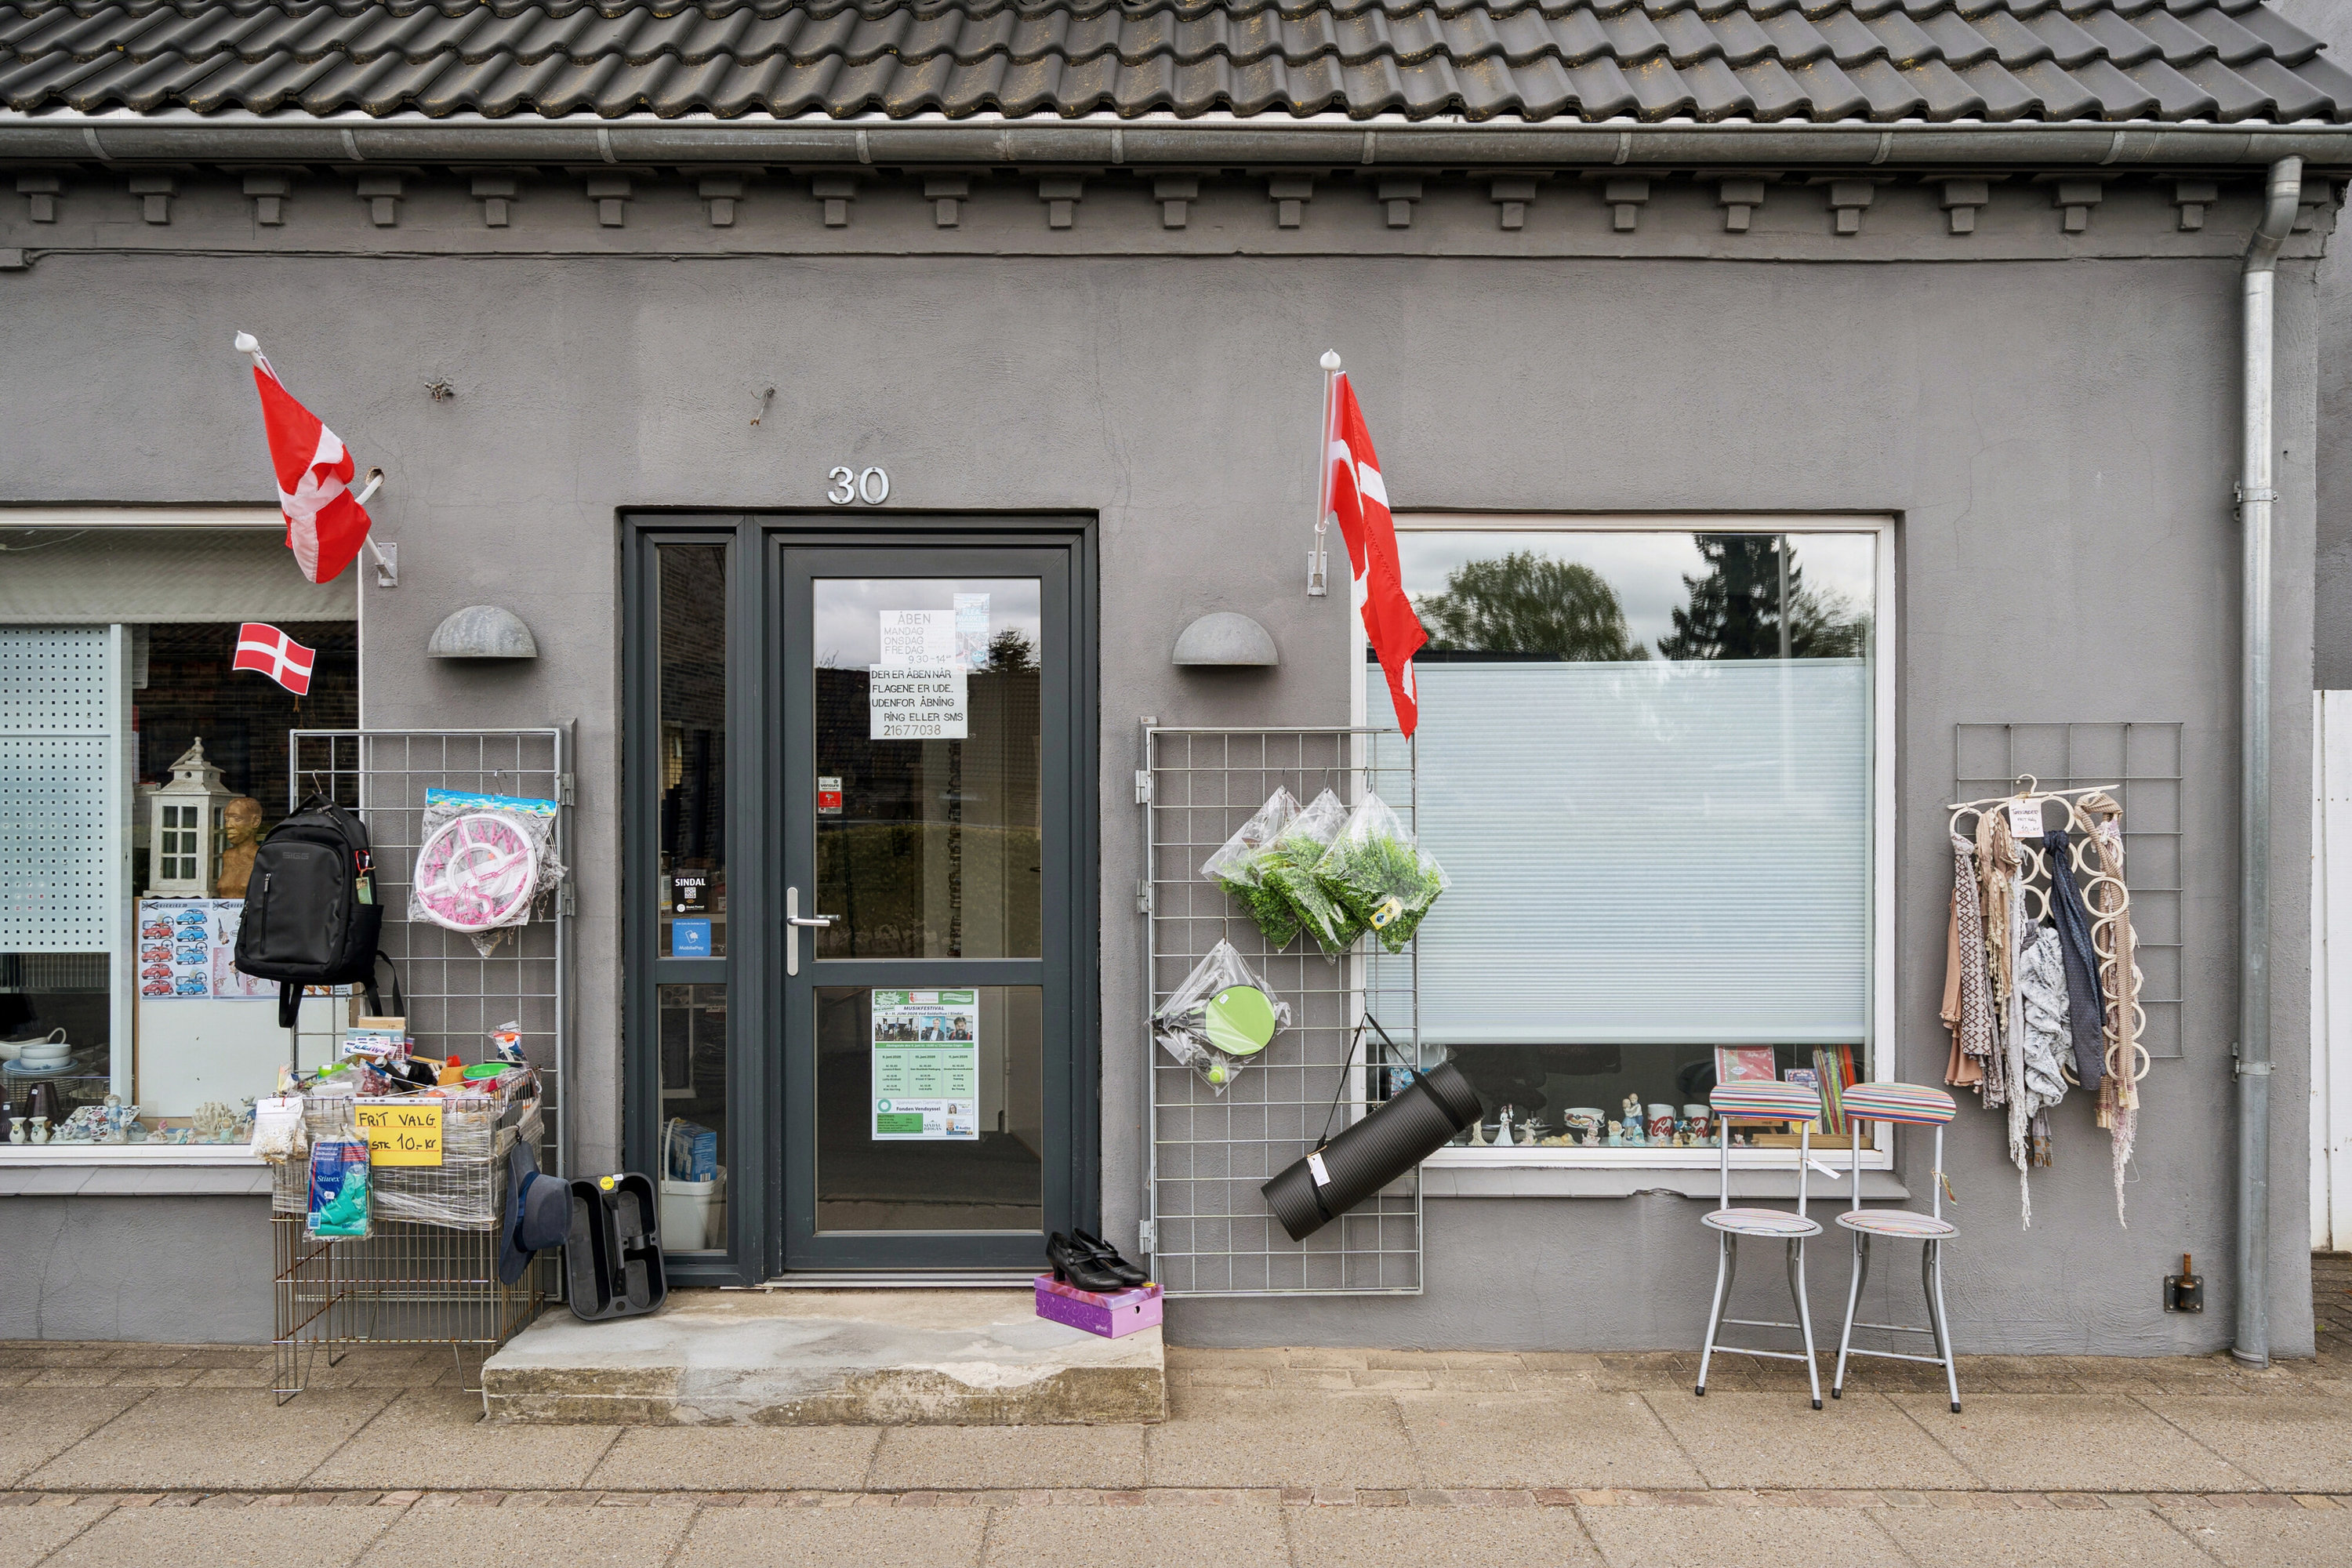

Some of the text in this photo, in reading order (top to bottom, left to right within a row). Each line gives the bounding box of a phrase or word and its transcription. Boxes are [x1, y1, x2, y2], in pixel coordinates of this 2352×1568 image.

[827, 465, 891, 506] 30
[898, 611, 931, 624] ÅBEN
[884, 626, 924, 636] MANDAG
[884, 636, 924, 645] ONSDAG
[884, 645, 924, 655] FREDAG
[871, 667, 952, 679] DER ER ÅBEN NÅR
[872, 684, 953, 693] FLAGENE ER UDE.
[872, 695, 955, 707] UDENFOR ÅBNING
[884, 711, 964, 722] RING ELLER SMS
[884, 724, 941, 736] 21677038
[282, 851, 310, 860] SIGG
[675, 878, 706, 887] SINDAL
[358, 1112, 436, 1127] FRIT VALG
[372, 1141, 390, 1150] STK
